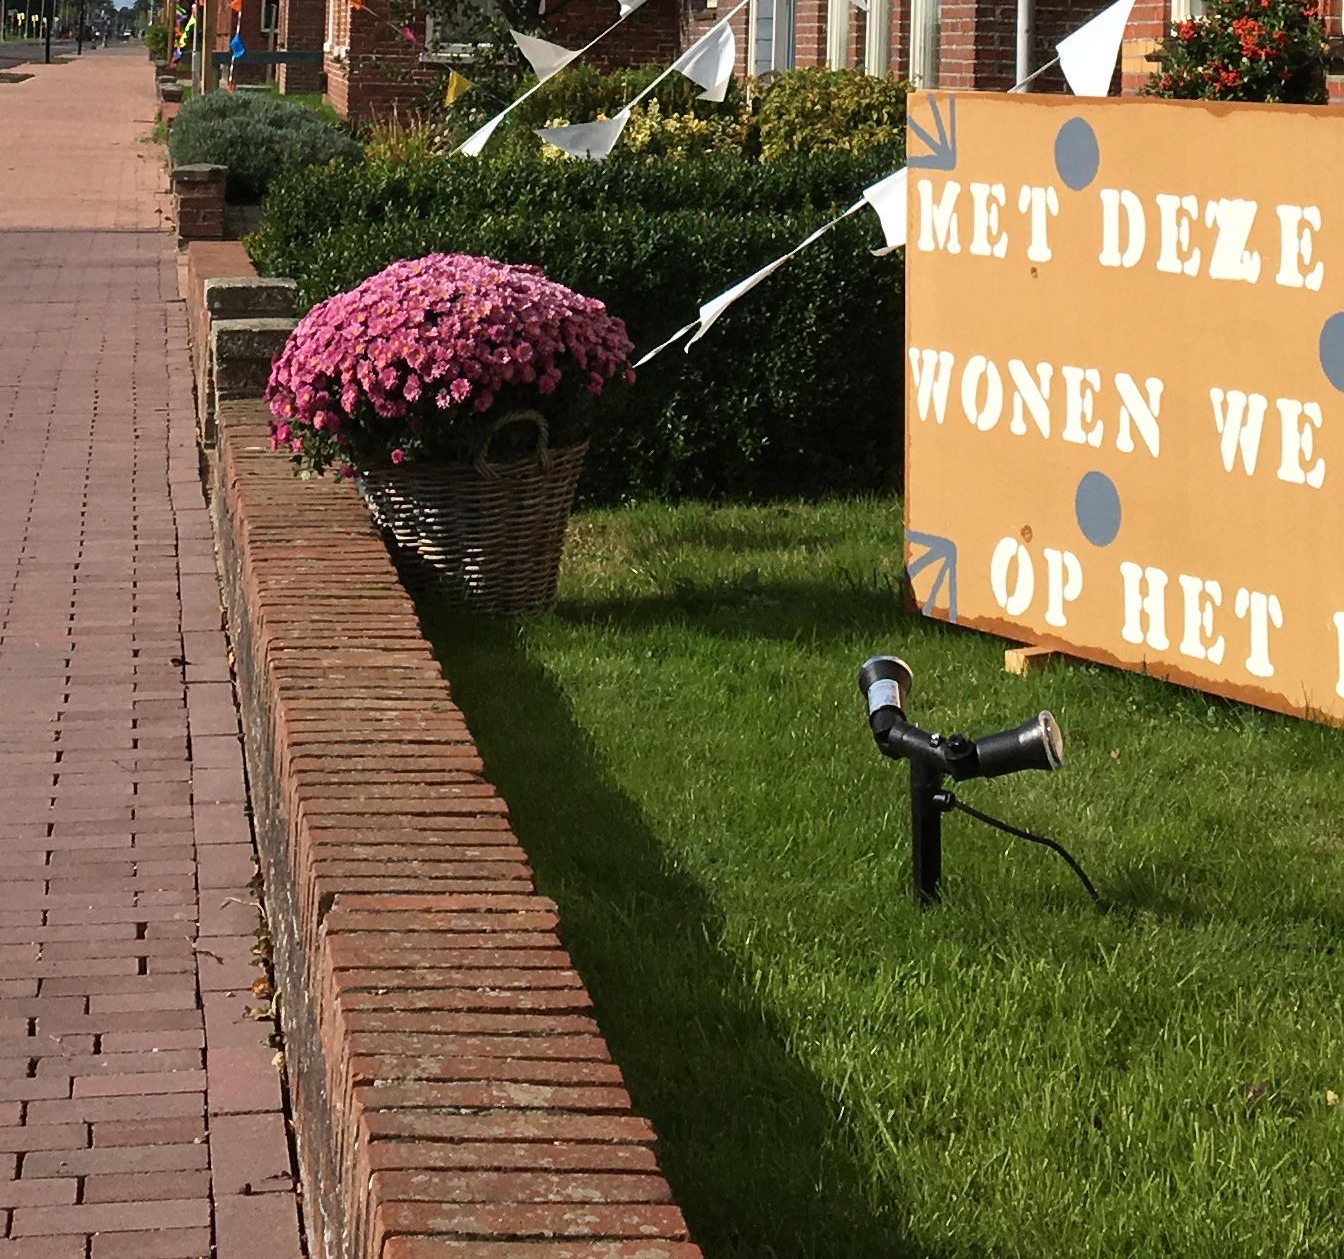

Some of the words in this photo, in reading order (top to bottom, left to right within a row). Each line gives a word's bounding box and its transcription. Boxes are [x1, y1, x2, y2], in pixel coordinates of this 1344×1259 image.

[916, 179, 1059, 262] MET
[1098, 188, 1324, 291] DEZE
[908, 346, 1164, 459] WONEN
[1209, 387, 1326, 489] WE
[990, 536, 1083, 627] OP
[1119, 561, 1284, 678] HET
